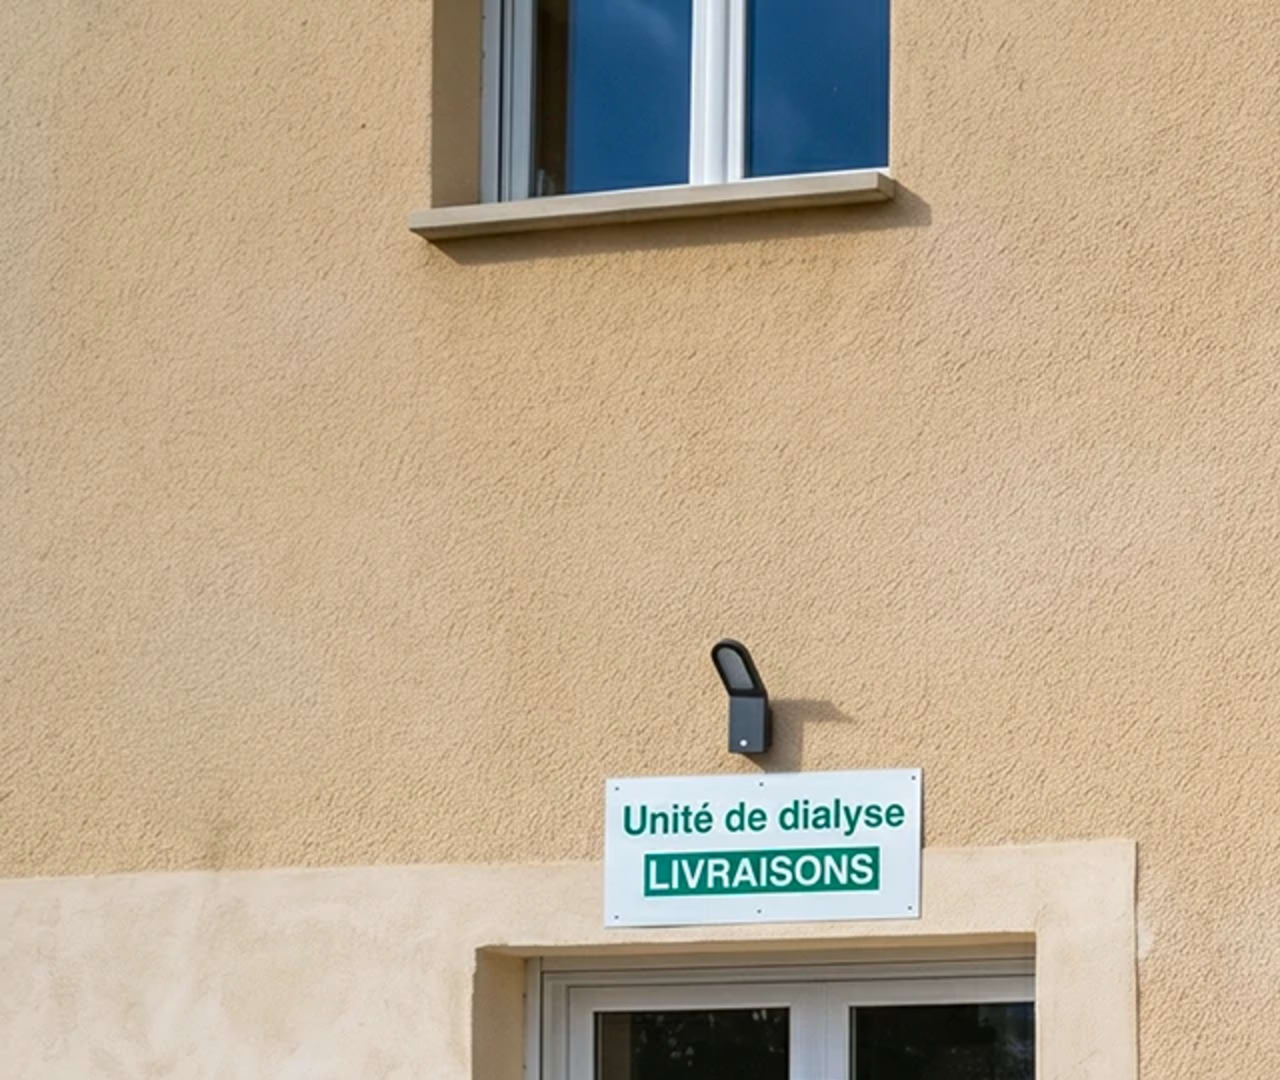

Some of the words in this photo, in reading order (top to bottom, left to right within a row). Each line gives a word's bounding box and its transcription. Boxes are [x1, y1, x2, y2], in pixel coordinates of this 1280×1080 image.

[623, 802, 713, 836] Unité
[725, 801, 767, 832] de
[778, 798, 905, 836] dialyse
[649, 853, 874, 890] LIVRAISONS
